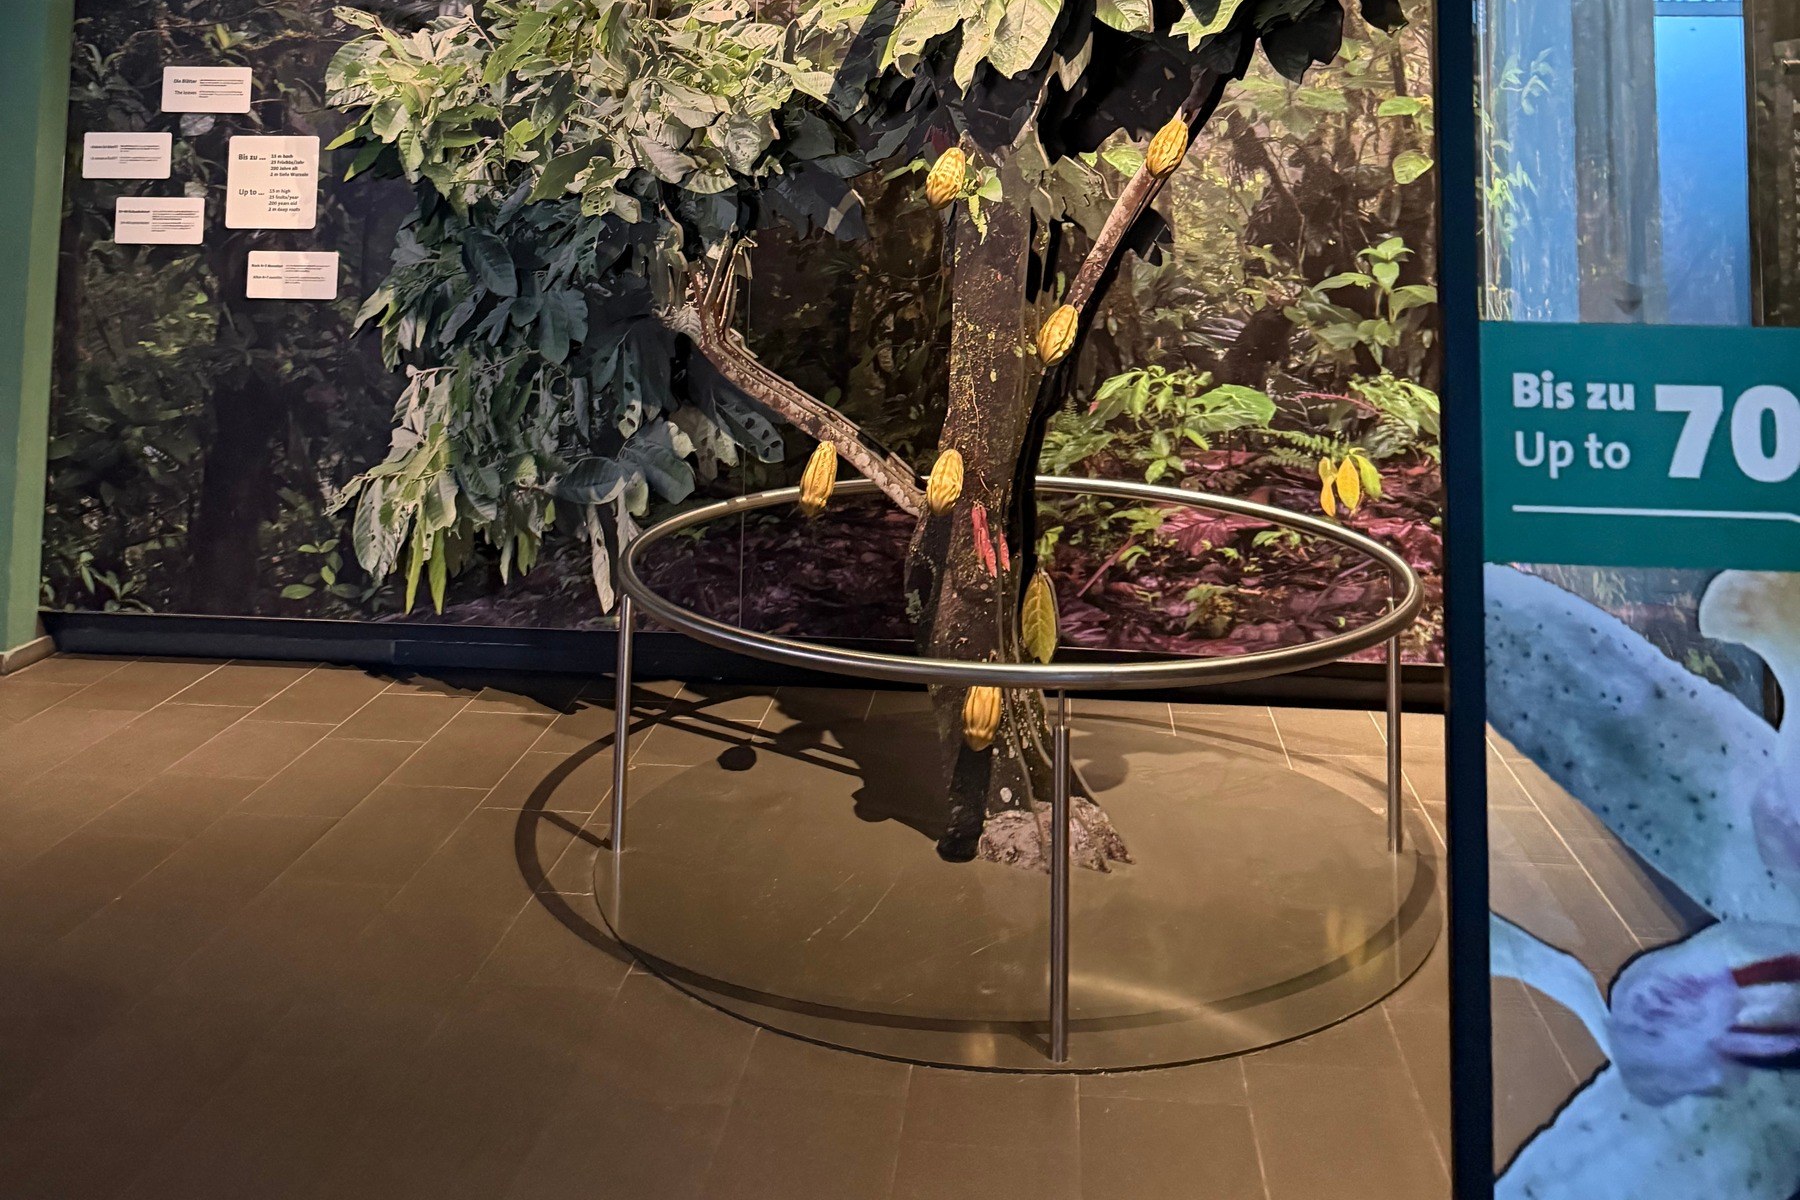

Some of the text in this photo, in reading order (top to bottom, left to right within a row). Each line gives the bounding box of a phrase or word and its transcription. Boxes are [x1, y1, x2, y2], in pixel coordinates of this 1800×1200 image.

[238, 188, 249, 197] Up
[1512, 370, 1800, 484] Bis zu 70
[1514, 430, 1632, 479] Up to
